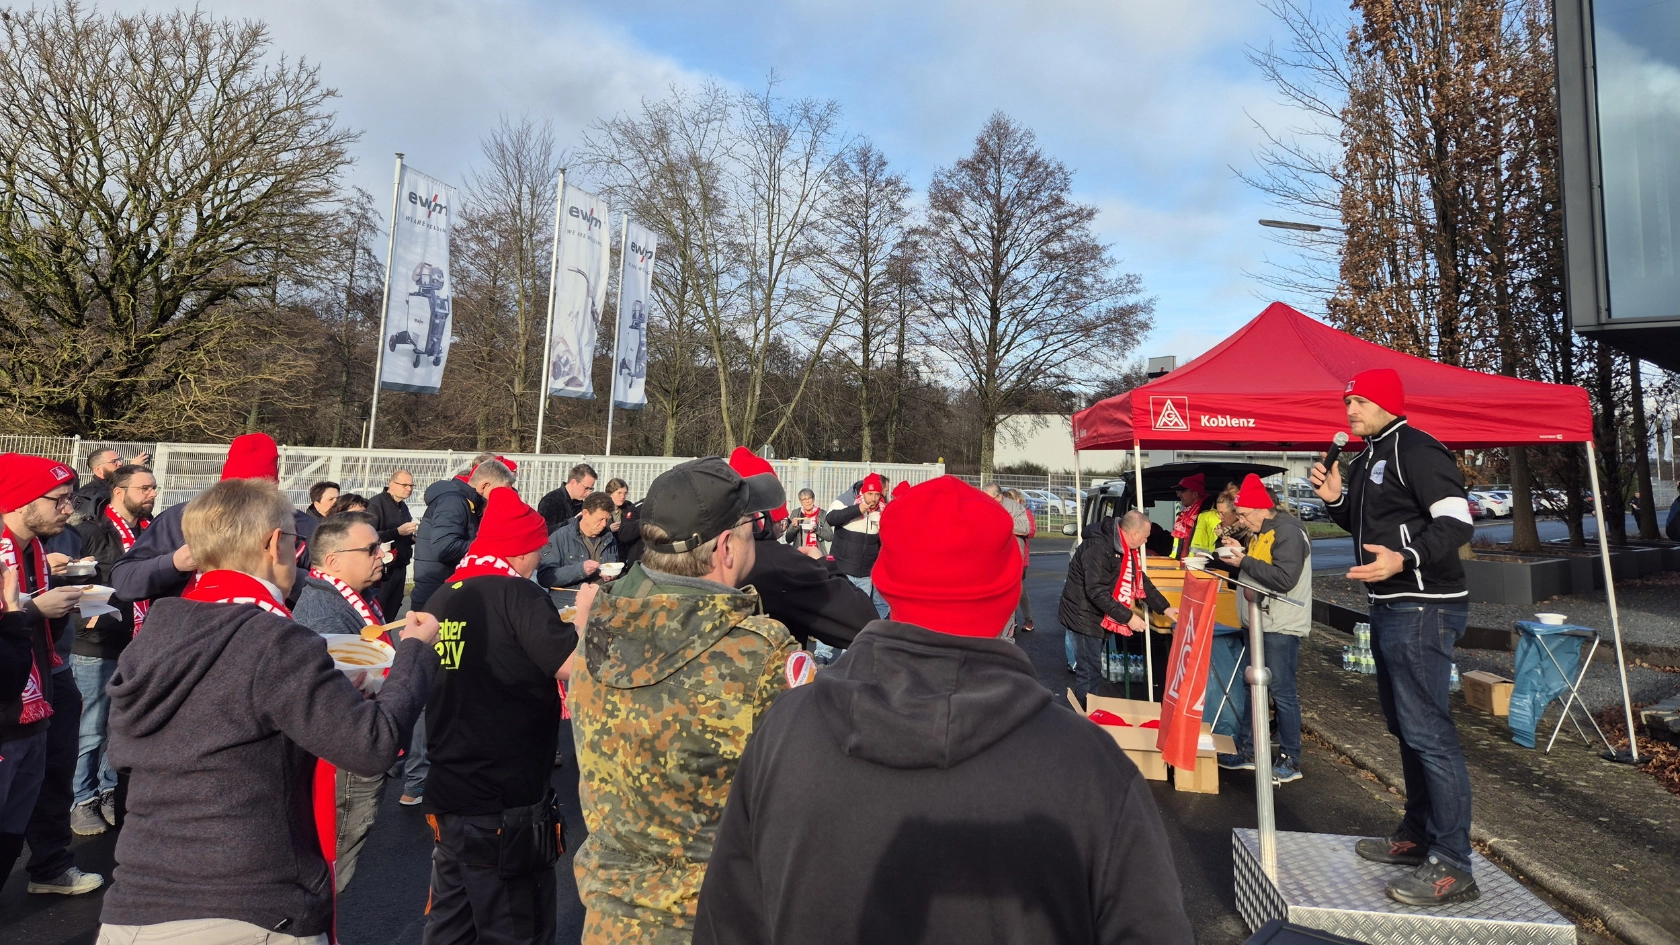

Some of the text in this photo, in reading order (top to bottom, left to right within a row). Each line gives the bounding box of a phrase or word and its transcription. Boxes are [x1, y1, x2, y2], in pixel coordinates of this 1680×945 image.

[408, 191, 448, 219] ewm
[568, 205, 602, 231] ewm
[1200, 414, 1256, 428] Koblenz
[434, 640, 466, 670] exy
